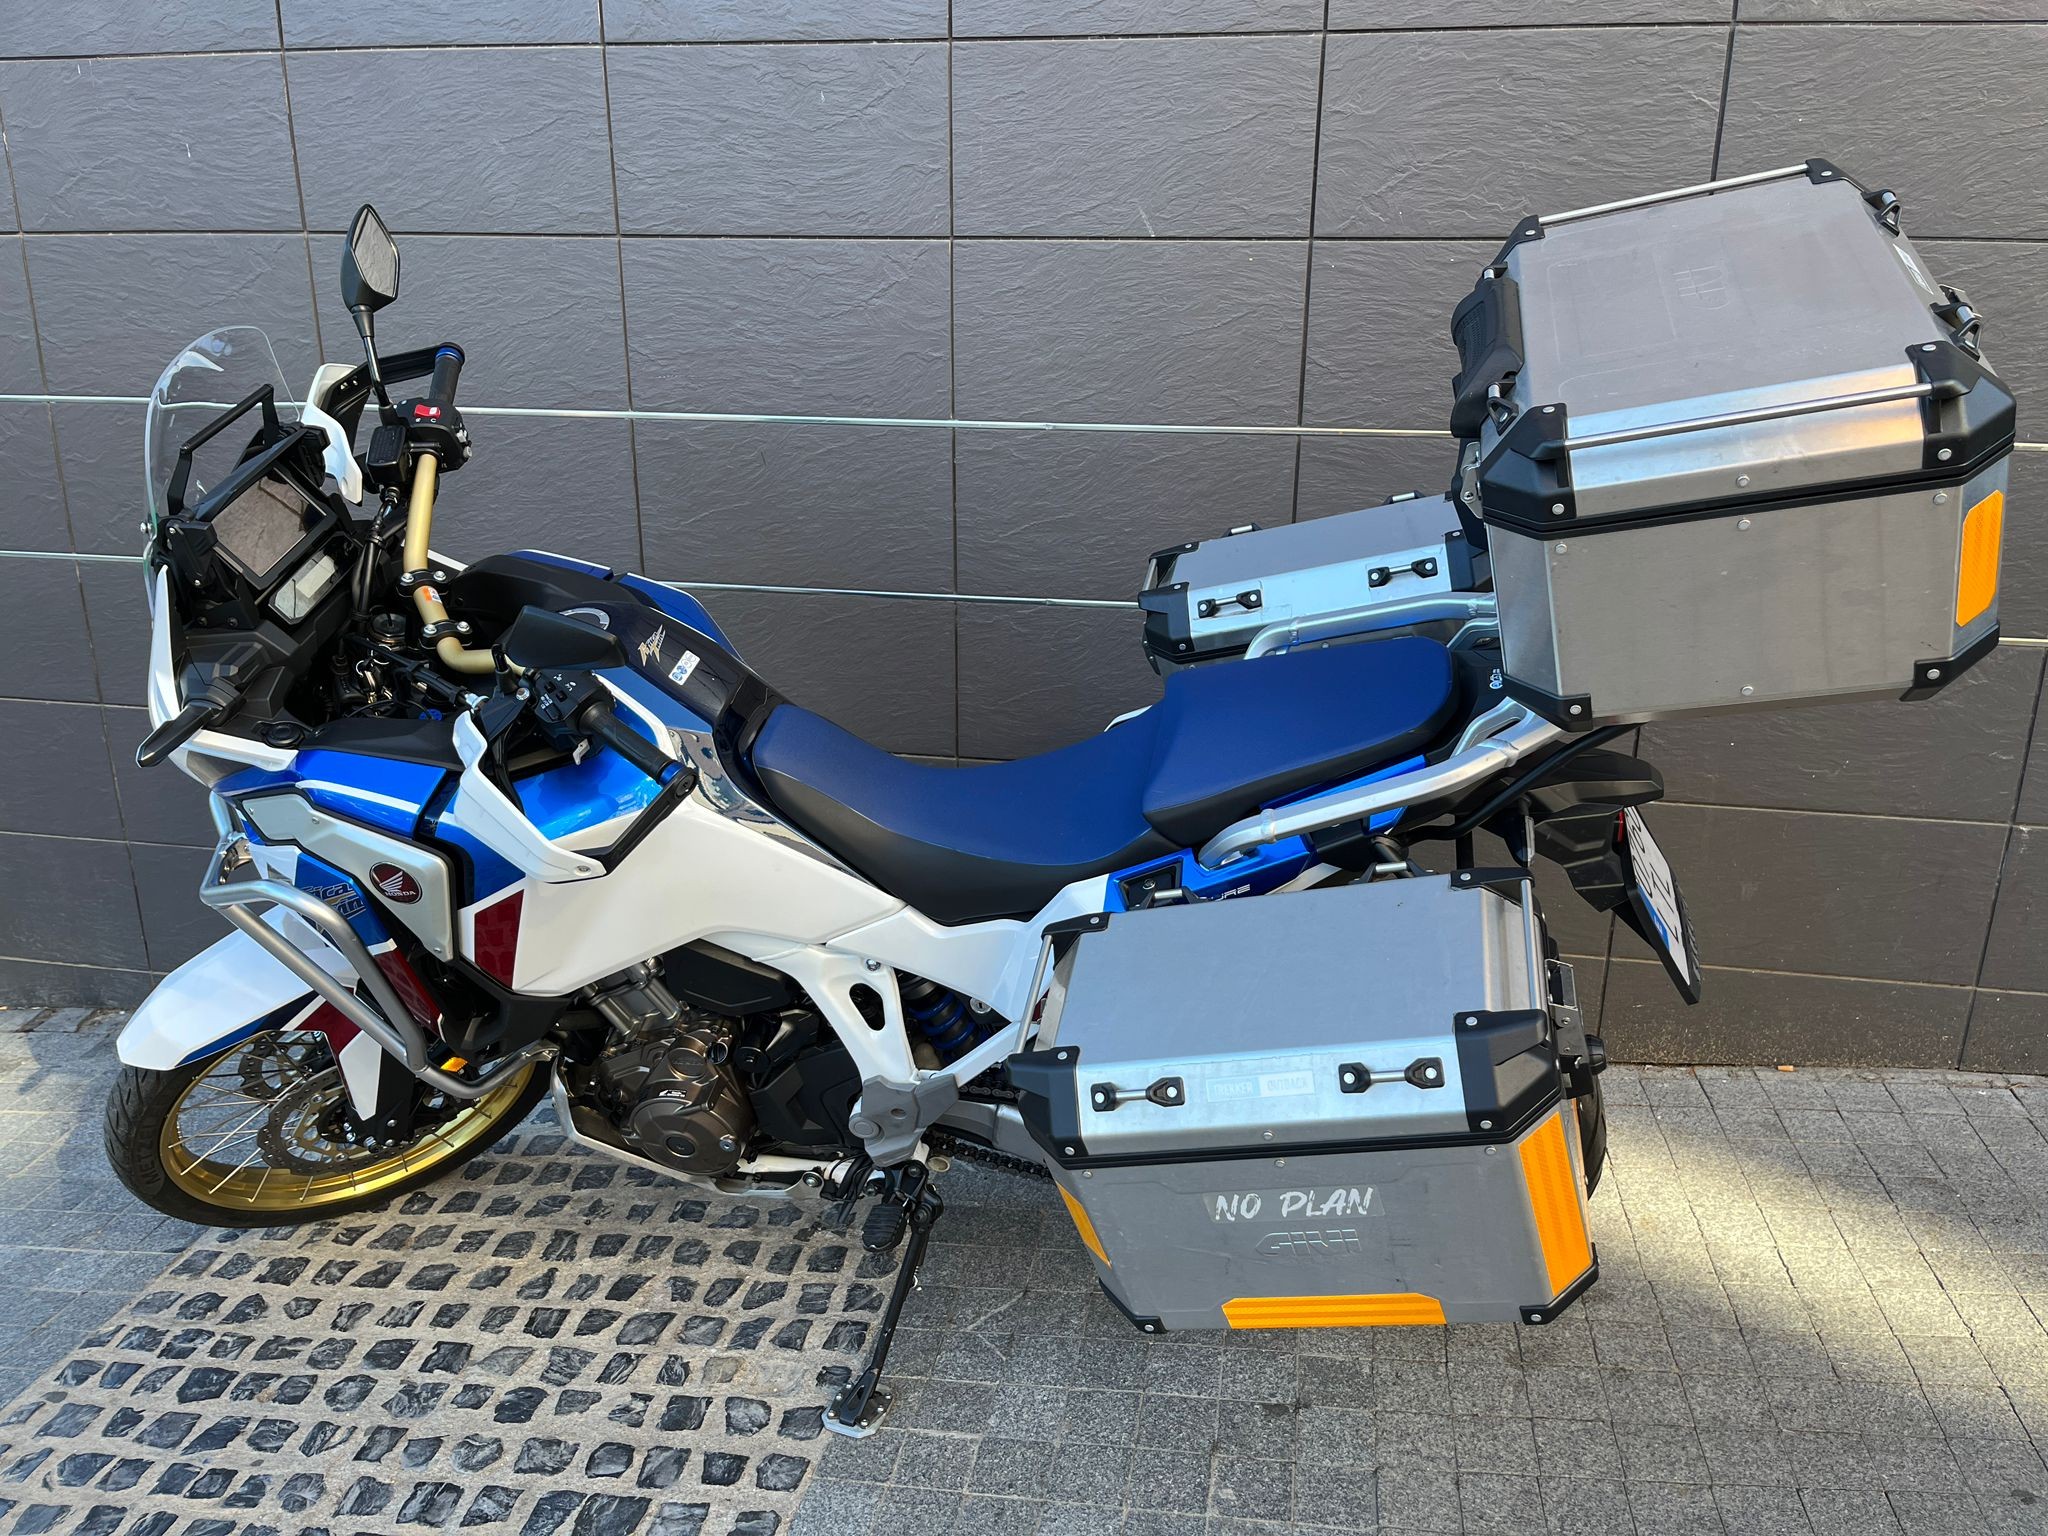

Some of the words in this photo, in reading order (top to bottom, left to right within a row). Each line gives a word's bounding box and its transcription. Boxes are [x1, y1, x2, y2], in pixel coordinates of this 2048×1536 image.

[383, 889, 417, 897] HONDA
[1213, 1081, 1254, 1098] TREKKER
[1215, 1192, 1262, 1222] NO
[1279, 1187, 1374, 1218] PLAN
[1255, 1229, 1362, 1256] GIVI
